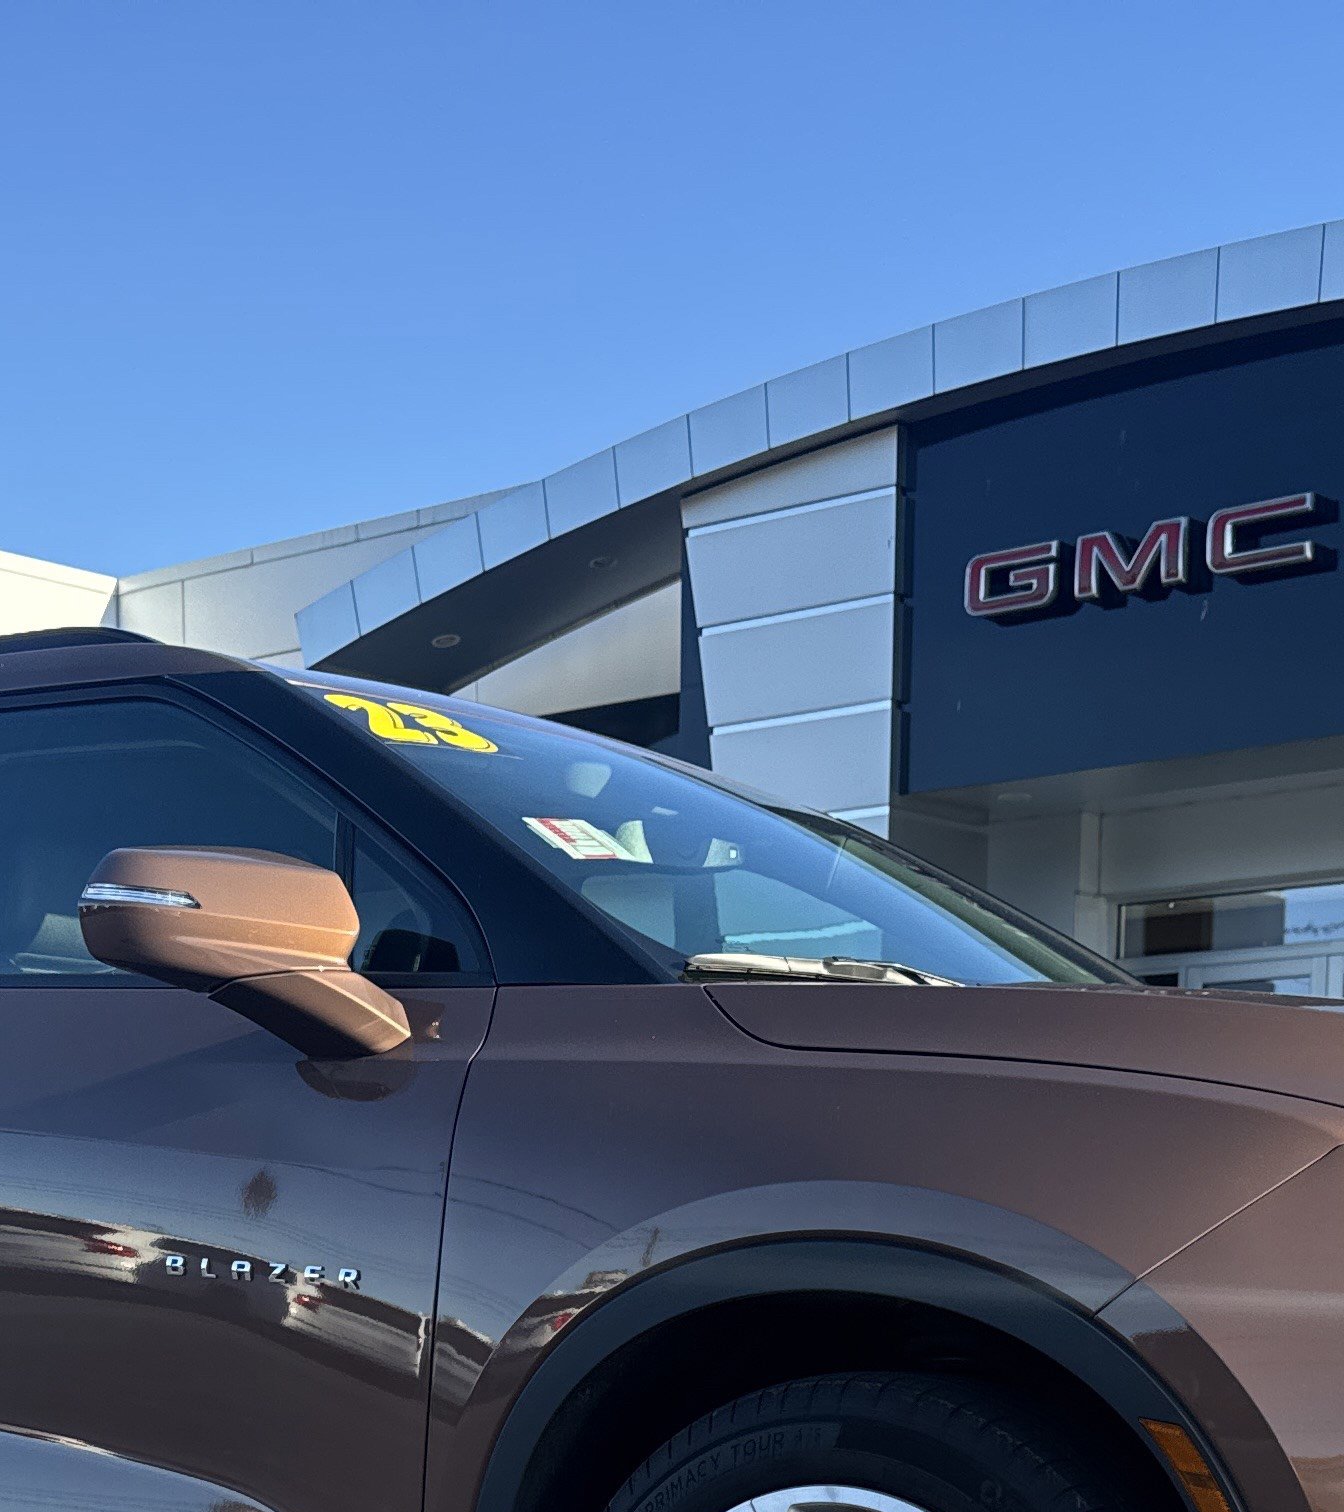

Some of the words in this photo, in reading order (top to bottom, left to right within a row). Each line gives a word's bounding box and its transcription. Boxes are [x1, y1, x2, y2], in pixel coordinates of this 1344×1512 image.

[964, 492, 1315, 617] GMC
[323, 694, 499, 753] 23
[164, 1254, 363, 1290] BLAZER
[730, 1430, 785, 1469] TOUR
